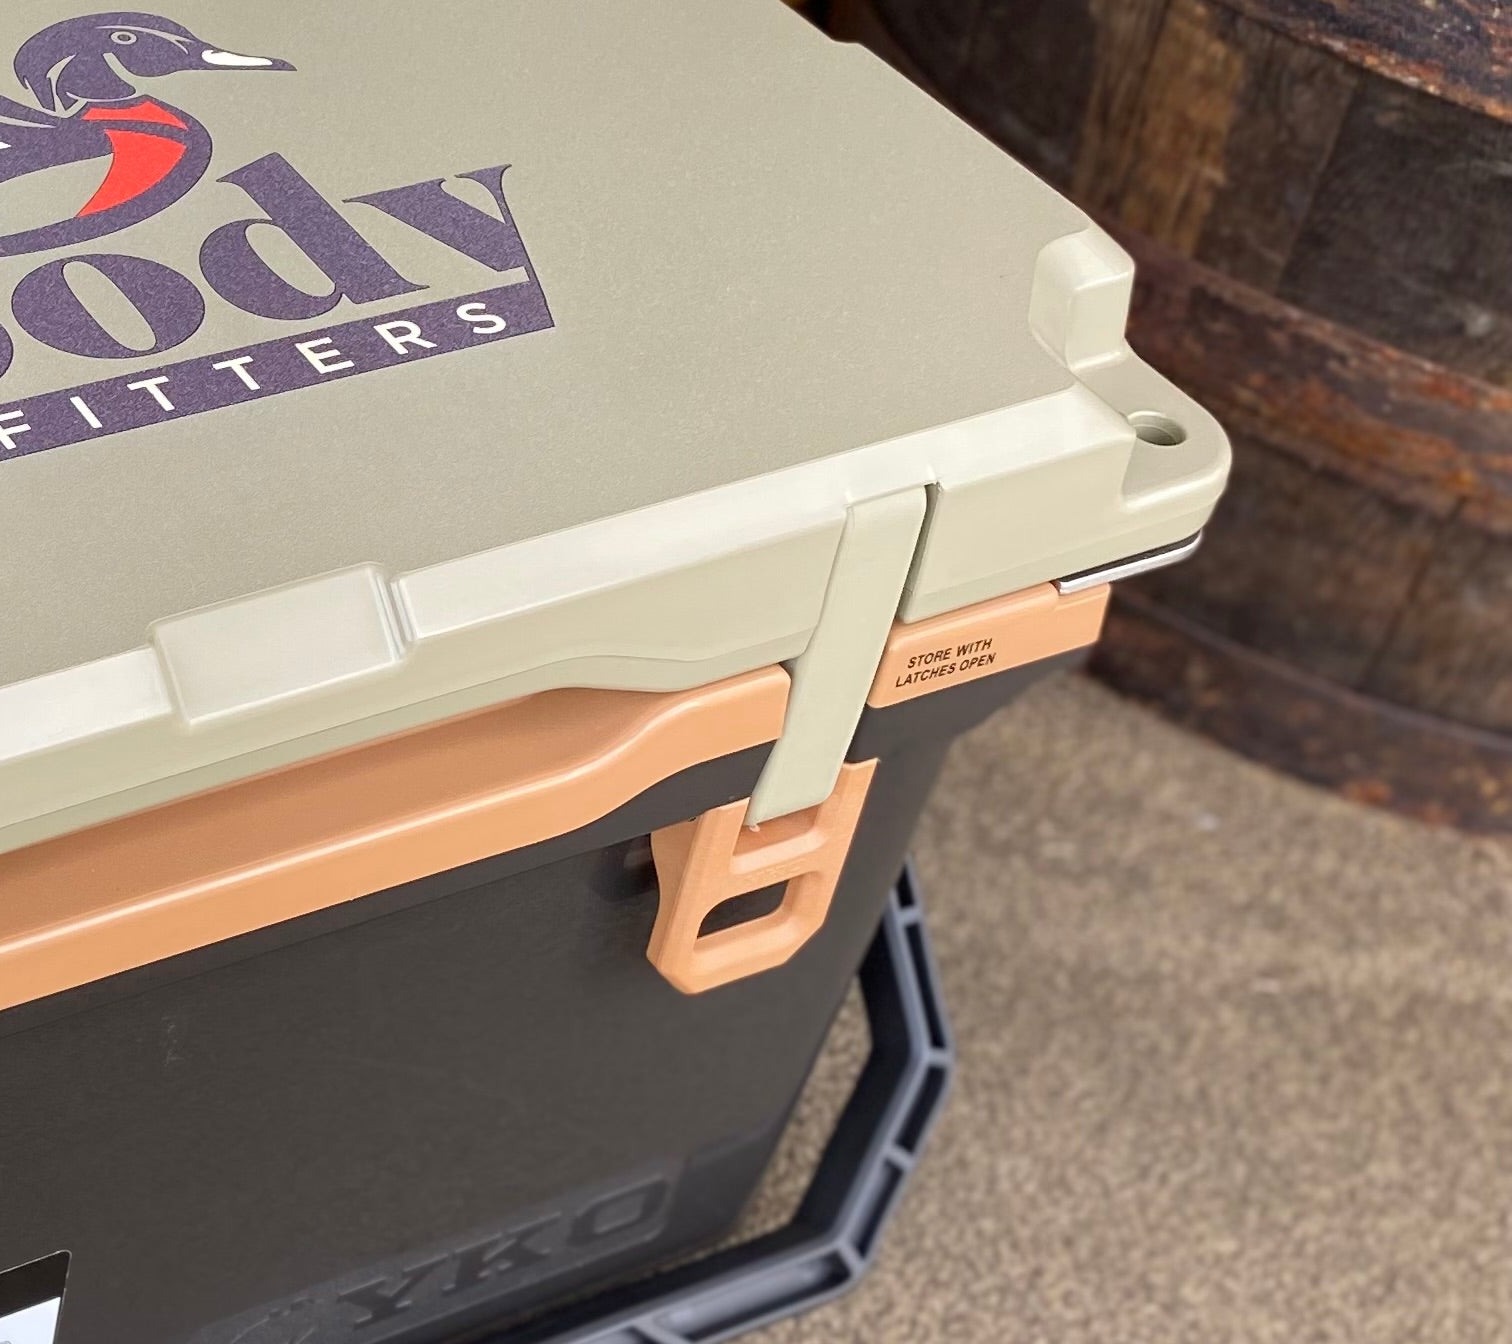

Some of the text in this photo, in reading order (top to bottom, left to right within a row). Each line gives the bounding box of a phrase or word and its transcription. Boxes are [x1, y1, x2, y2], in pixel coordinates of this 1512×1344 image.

[894, 652, 996, 688] LATCHES OPEN
[906, 638, 993, 670] STORE WITH
[335, 1174, 672, 1331] YKO
